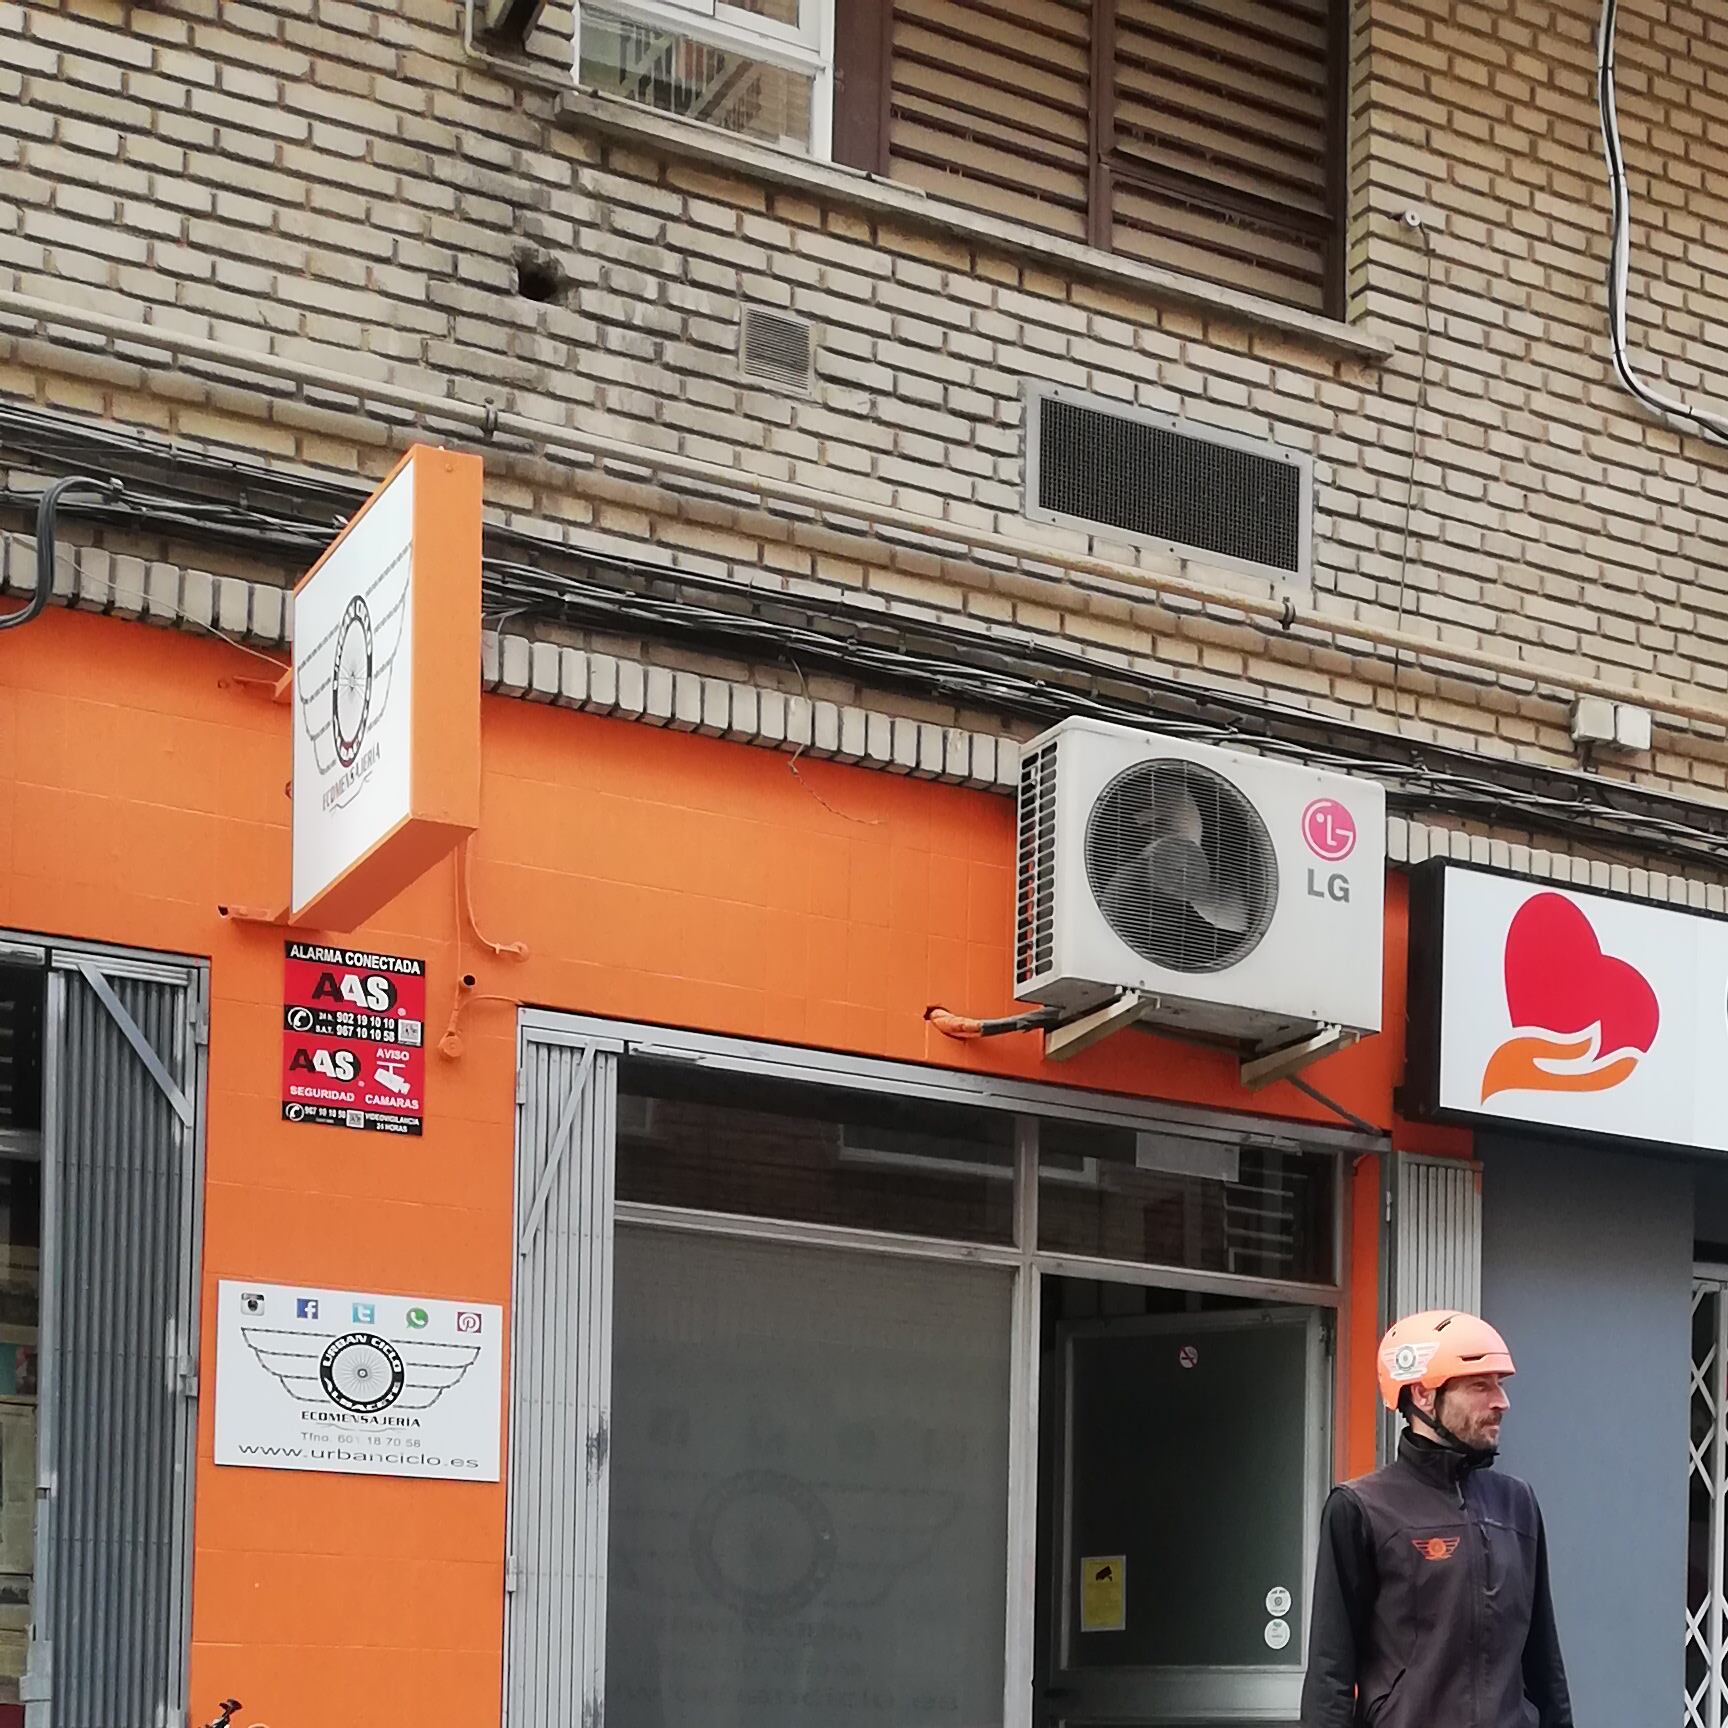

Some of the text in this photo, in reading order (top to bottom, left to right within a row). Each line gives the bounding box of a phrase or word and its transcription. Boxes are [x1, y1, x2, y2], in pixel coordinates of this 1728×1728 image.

[1307, 869, 1350, 902] LG
[290, 945, 420, 975] ALARMA CONECTADA
[336, 1012, 354, 1024] 902
[357, 1014, 367, 1025] 19
[370, 1016, 381, 1027] 10
[383, 1018, 395, 1029] 10
[356, 1027, 368, 1038] 10
[370, 1028, 381, 1040] 10
[376, 1048, 410, 1060] AVISO
[289, 1085, 355, 1102] SEGURIDAD
[365, 1094, 419, 1109] CAMARAS
[323, 1334, 402, 1373] URBAN CICLO
[367, 1436, 381, 1446] 18
[386, 1437, 401, 1447] 70
[405, 1438, 421, 1448] 58
[238, 1443, 479, 1469] www.urbanciclo.es
